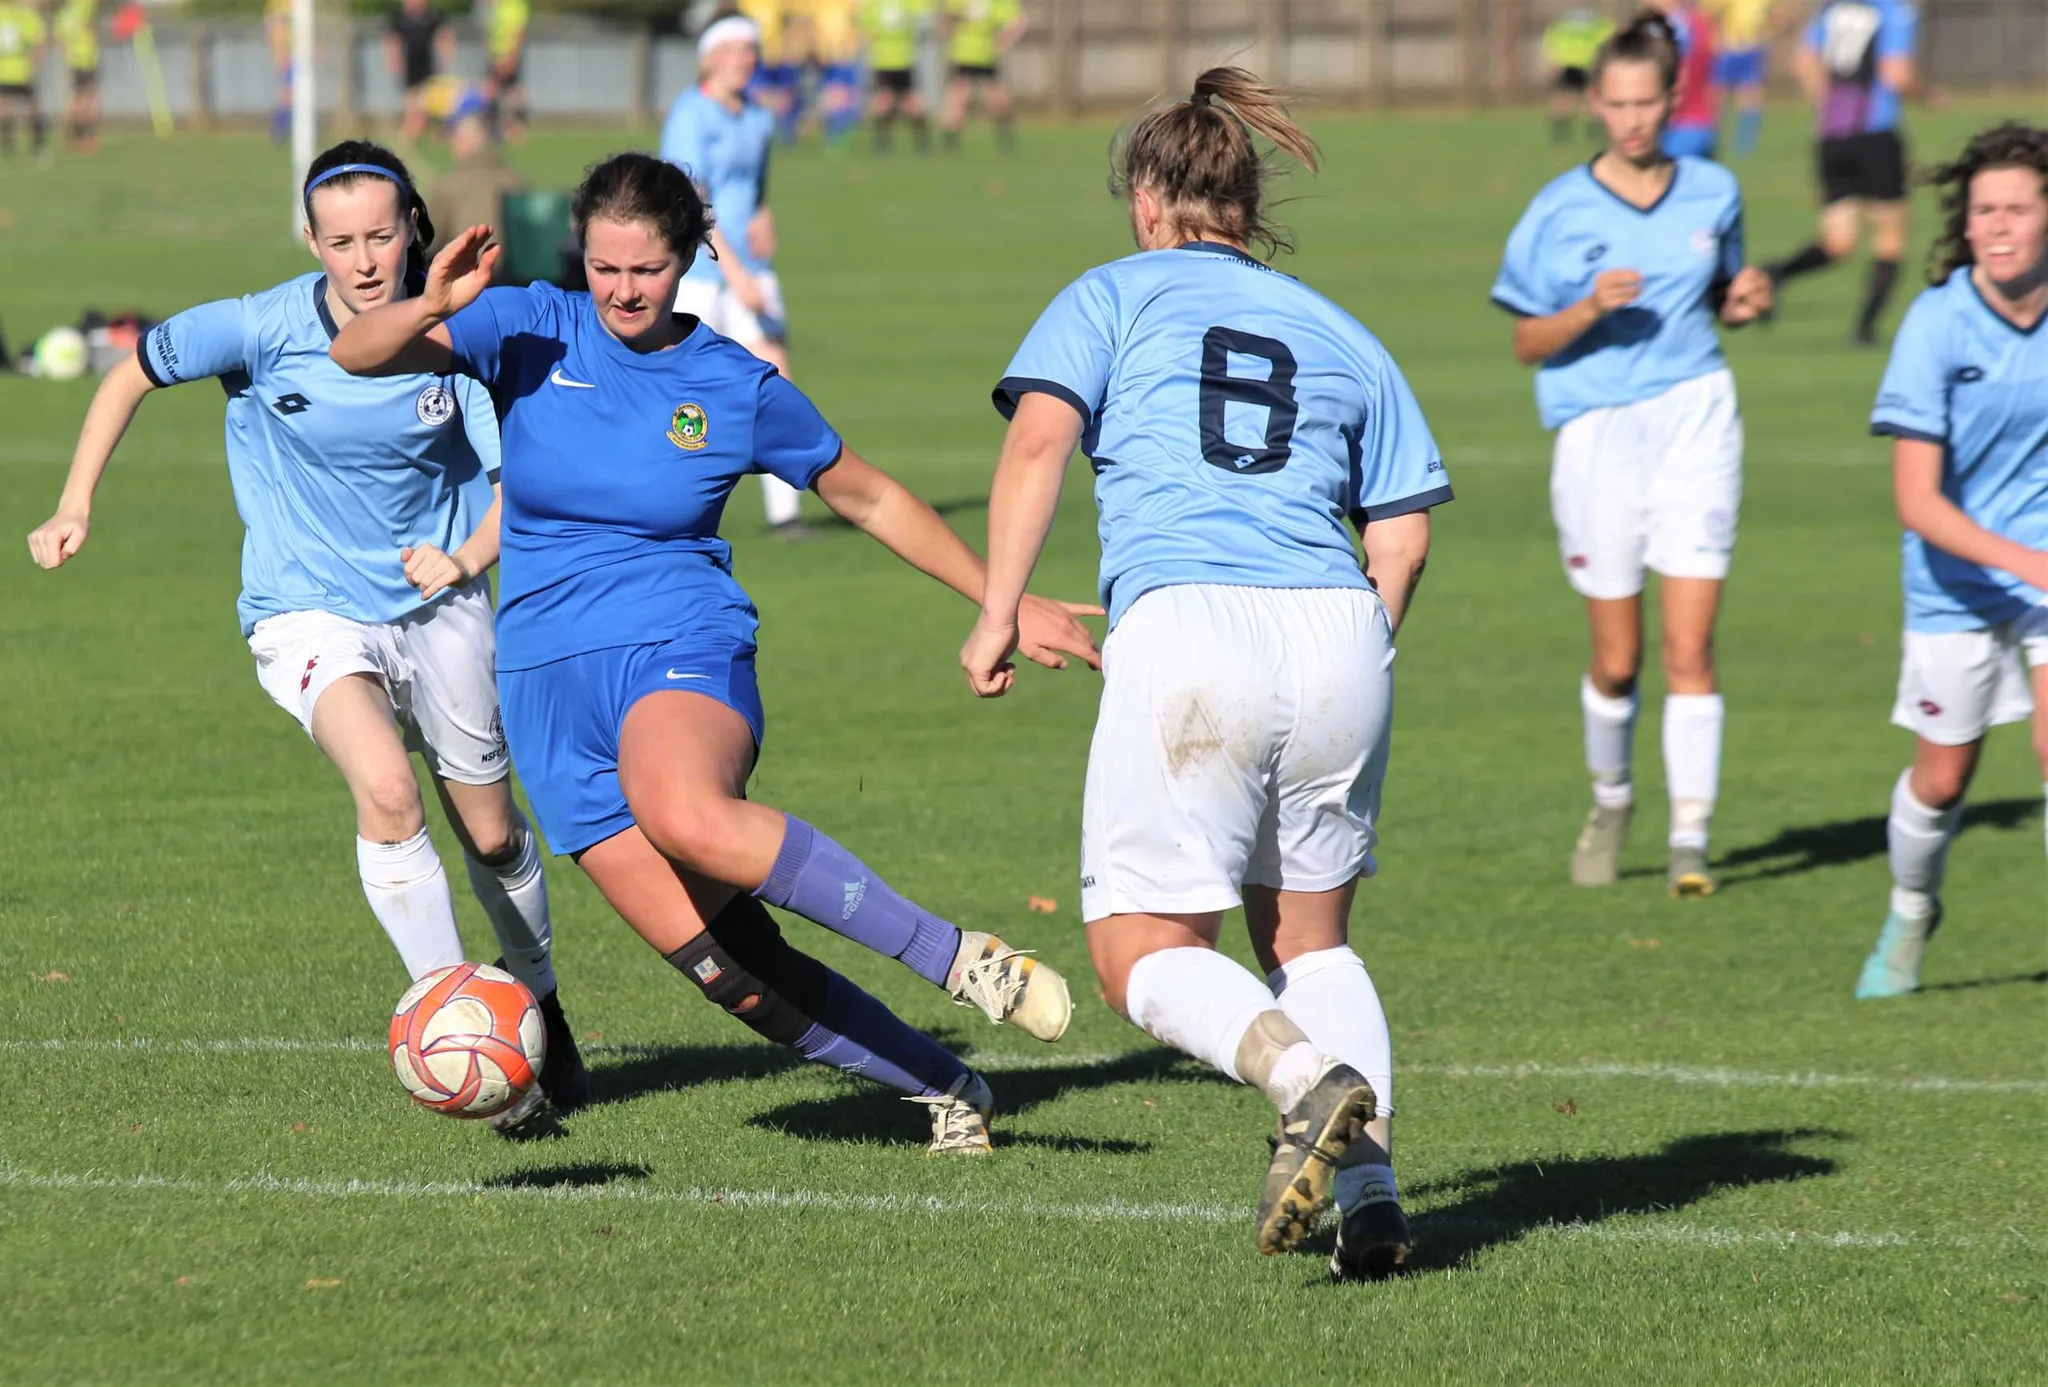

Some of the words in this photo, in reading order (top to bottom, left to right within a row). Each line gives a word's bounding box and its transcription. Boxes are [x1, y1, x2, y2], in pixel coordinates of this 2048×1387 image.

[169, 353, 179, 365] BY
[1199, 326, 1299, 474] 8
[481, 747, 502, 763] NSFC
[843, 876, 868, 920] adidas
